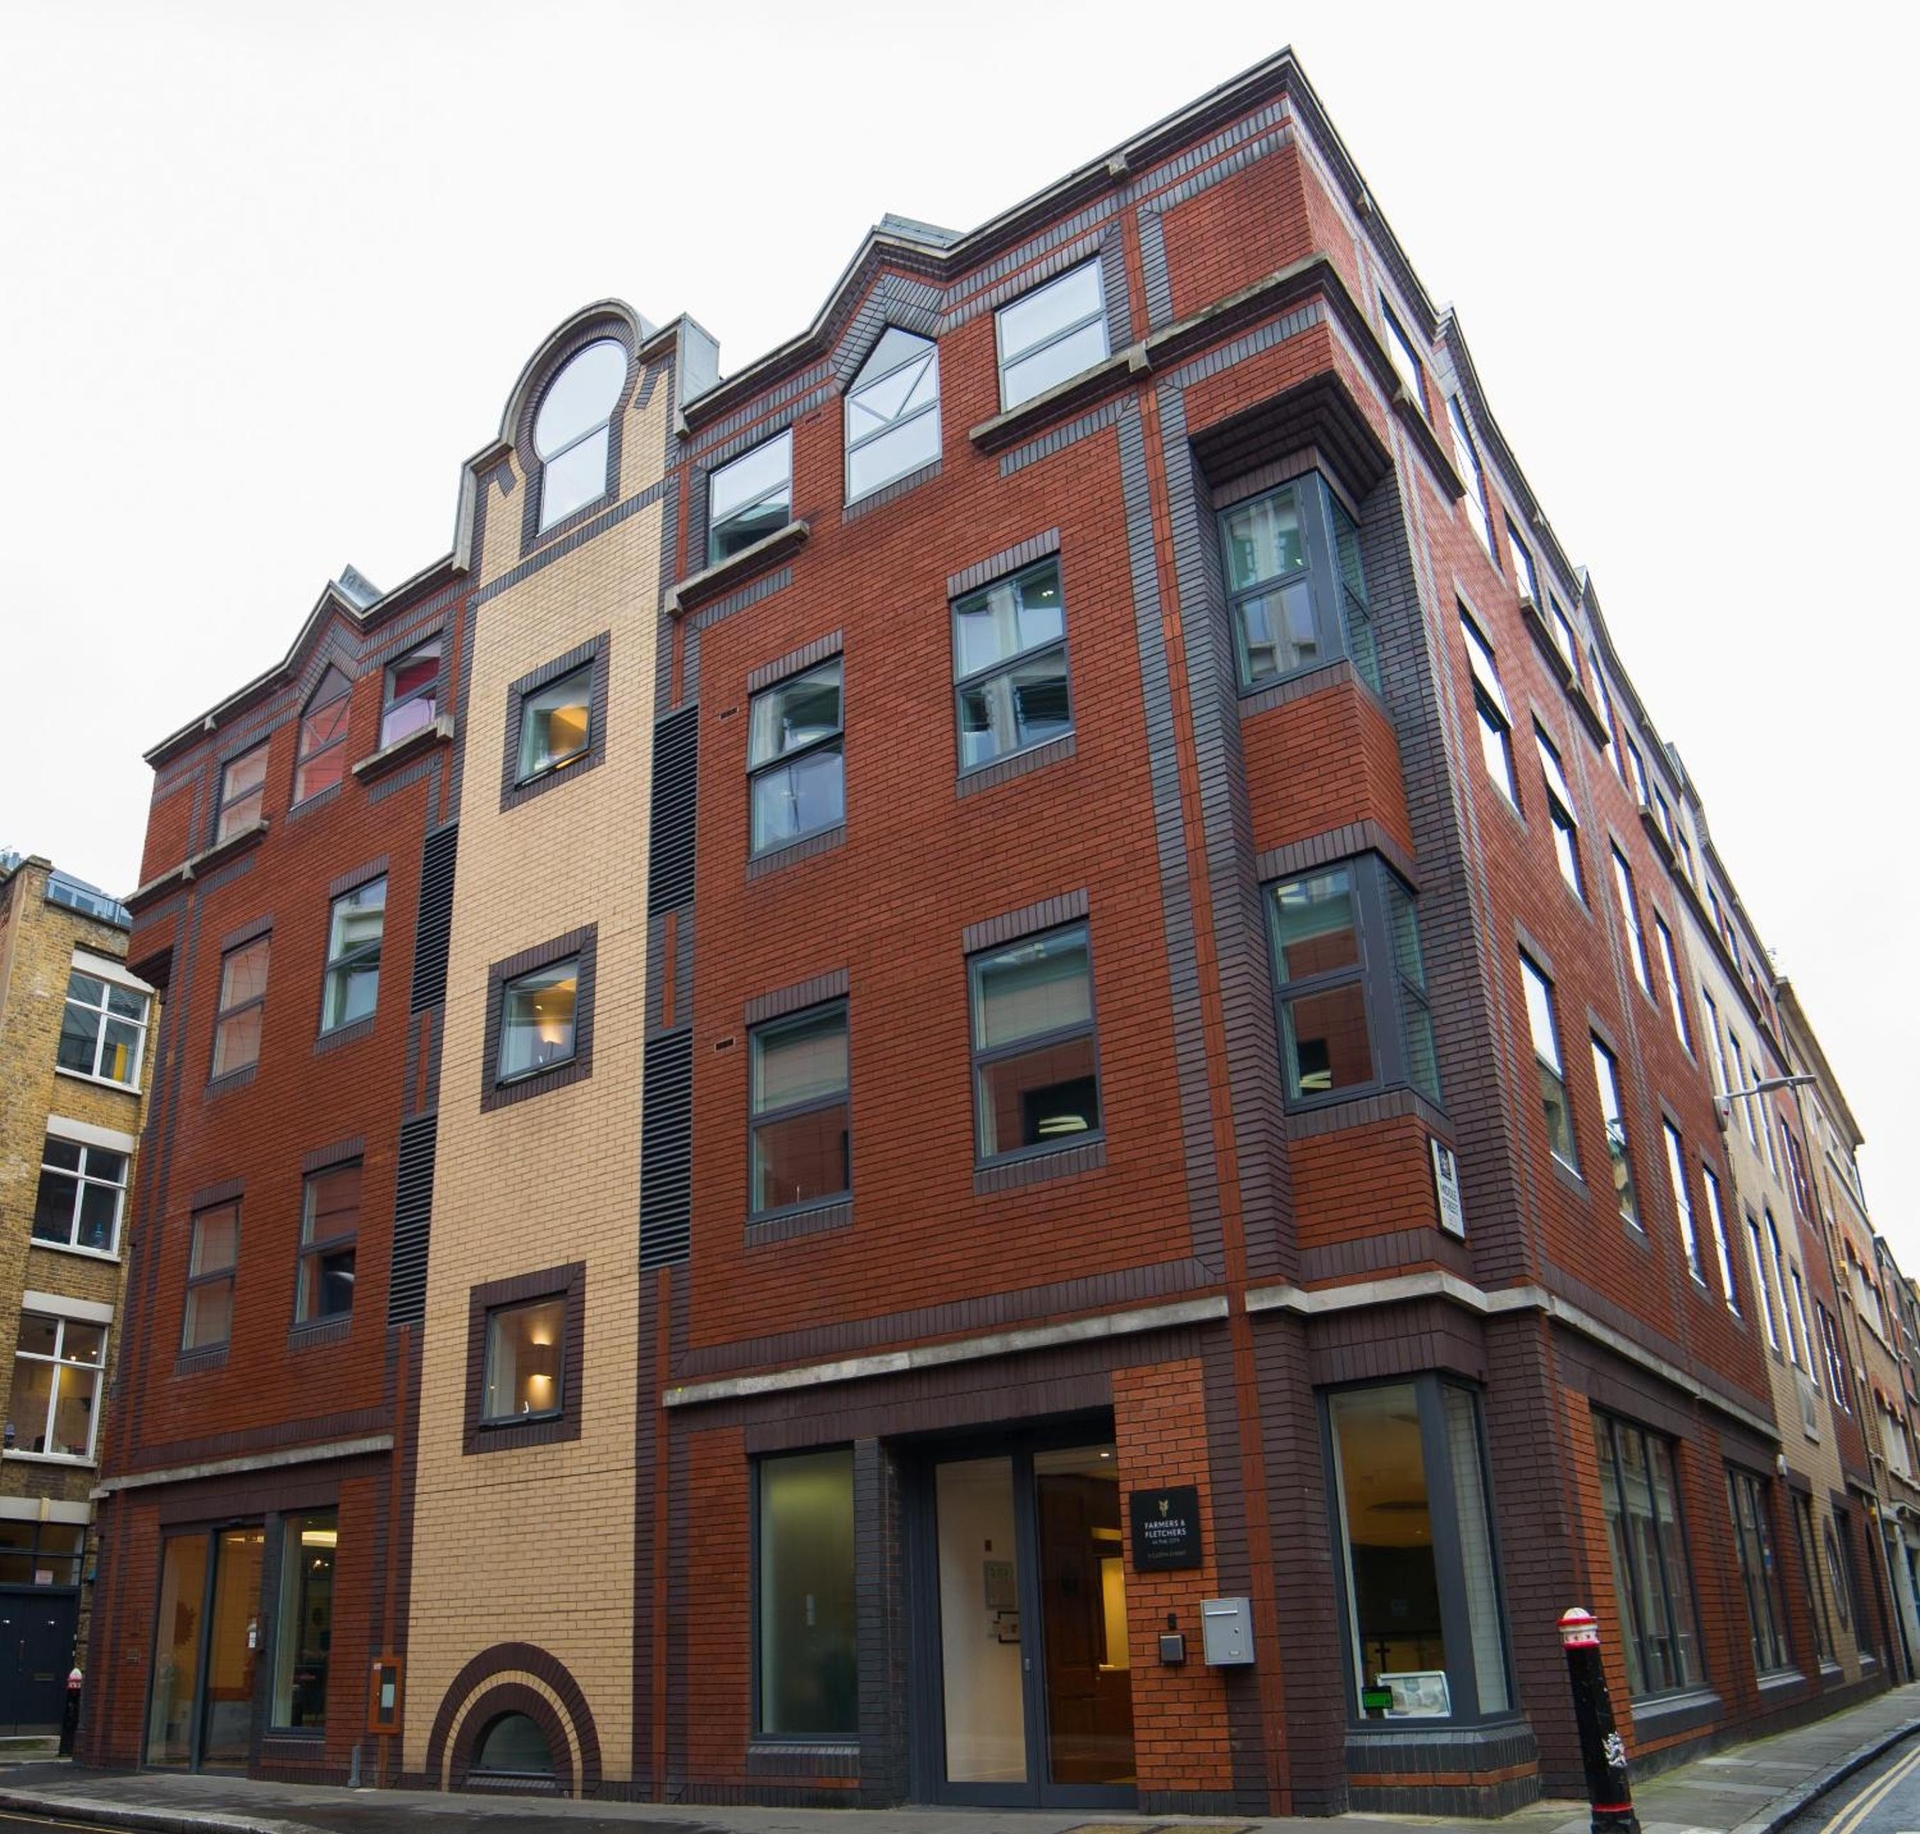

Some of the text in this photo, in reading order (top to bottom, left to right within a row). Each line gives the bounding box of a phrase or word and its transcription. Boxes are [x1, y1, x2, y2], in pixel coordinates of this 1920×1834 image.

[1144, 1518, 1186, 1530] FARMERS &
[1144, 1527, 1187, 1539] FLETCHERS
